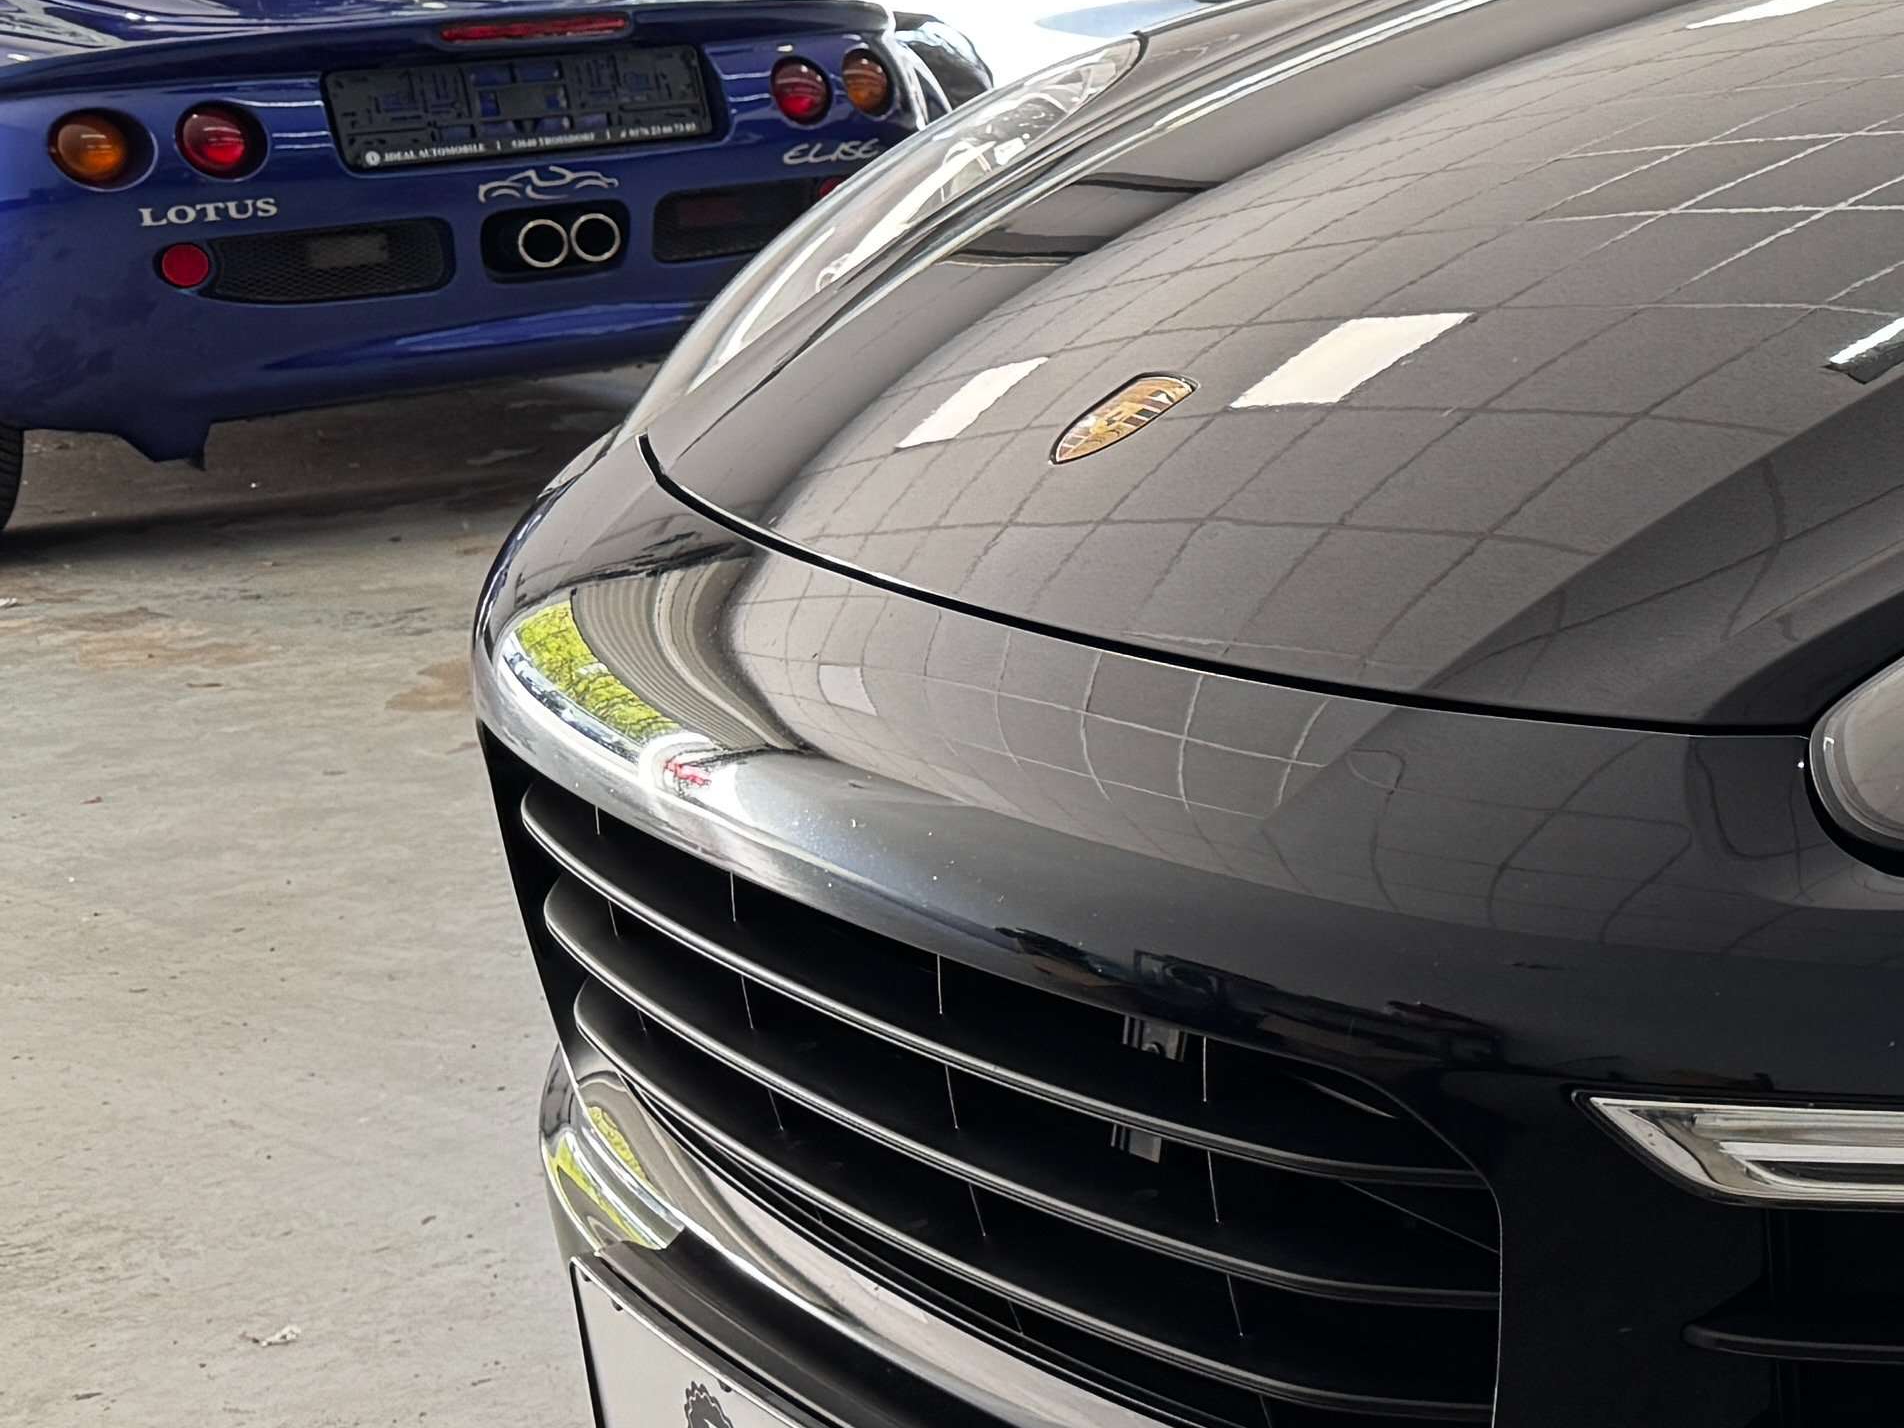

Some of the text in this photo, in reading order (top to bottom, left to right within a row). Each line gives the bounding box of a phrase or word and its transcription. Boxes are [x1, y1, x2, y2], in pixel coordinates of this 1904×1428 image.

[384, 149, 416, 163] IDEAL
[783, 137, 879, 165] ELISE
[138, 197, 278, 227] LOTUS
